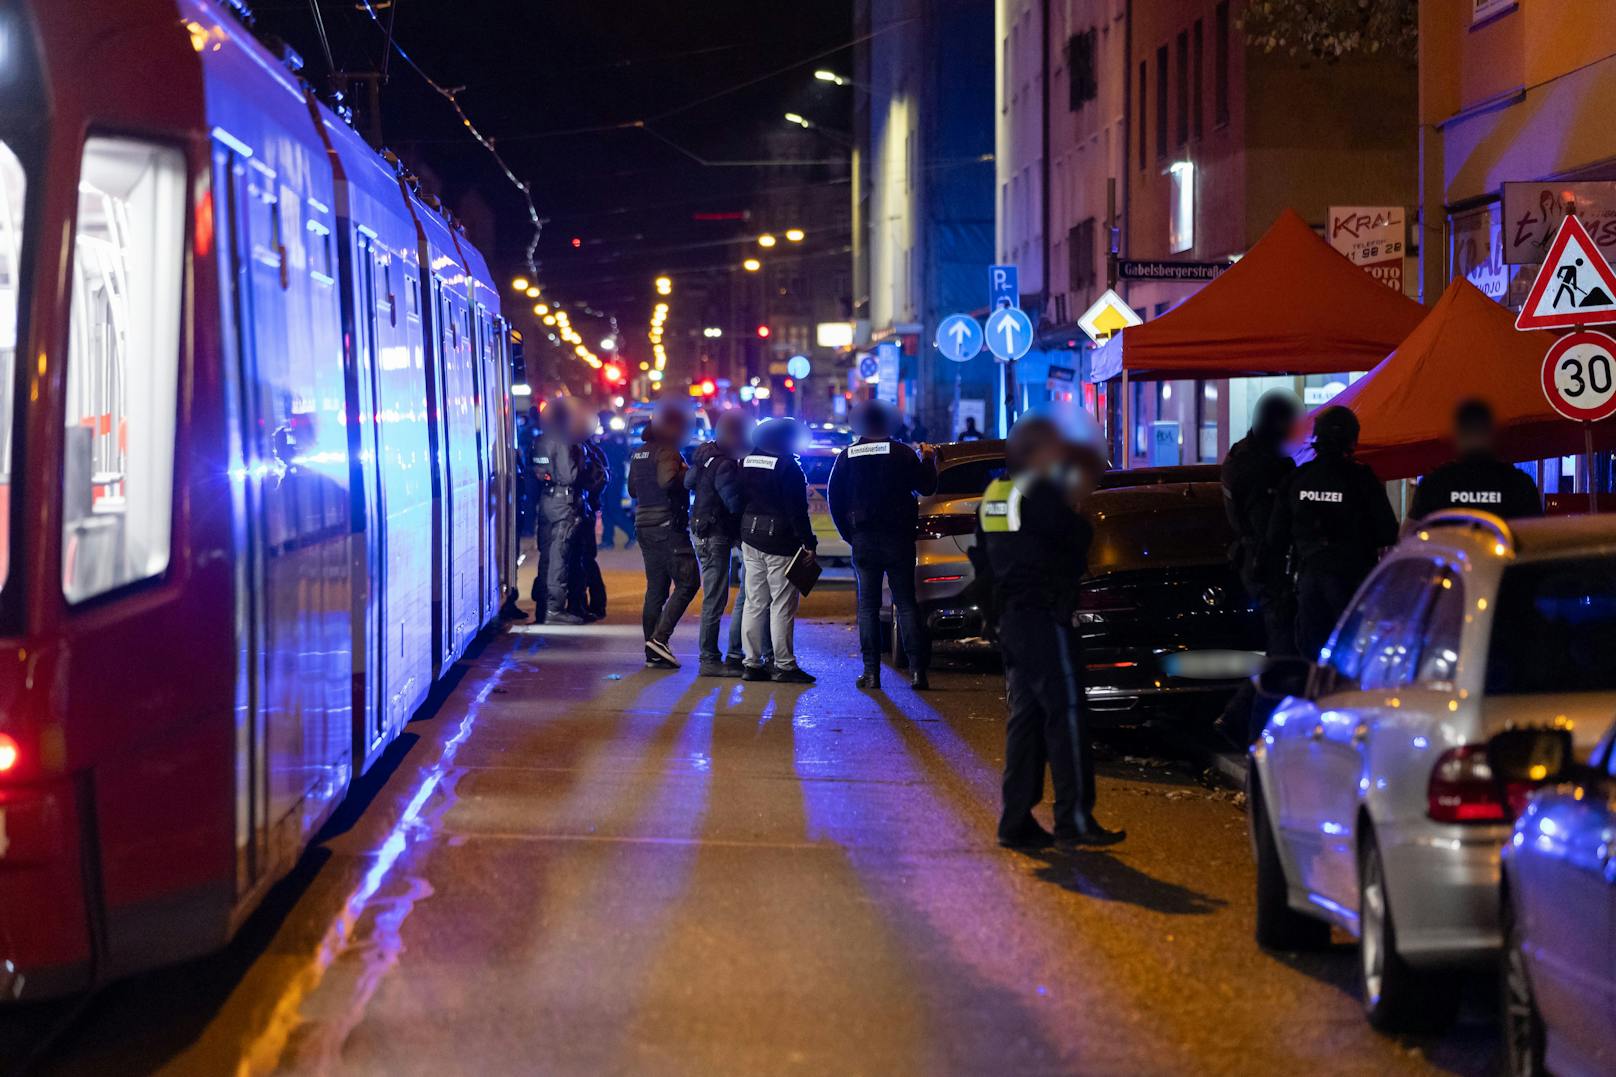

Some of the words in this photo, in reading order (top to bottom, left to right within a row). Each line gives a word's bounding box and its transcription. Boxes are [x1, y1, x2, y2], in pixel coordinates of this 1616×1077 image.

[1332, 210, 1402, 239] KRAL
[1124, 263, 1226, 277] Gabelsbergerstraße
[994, 269, 1007, 291] P
[1561, 354, 1612, 398] 30
[1299, 490, 1343, 503] POLIZEI
[1450, 491, 1502, 504] POLIZEI
